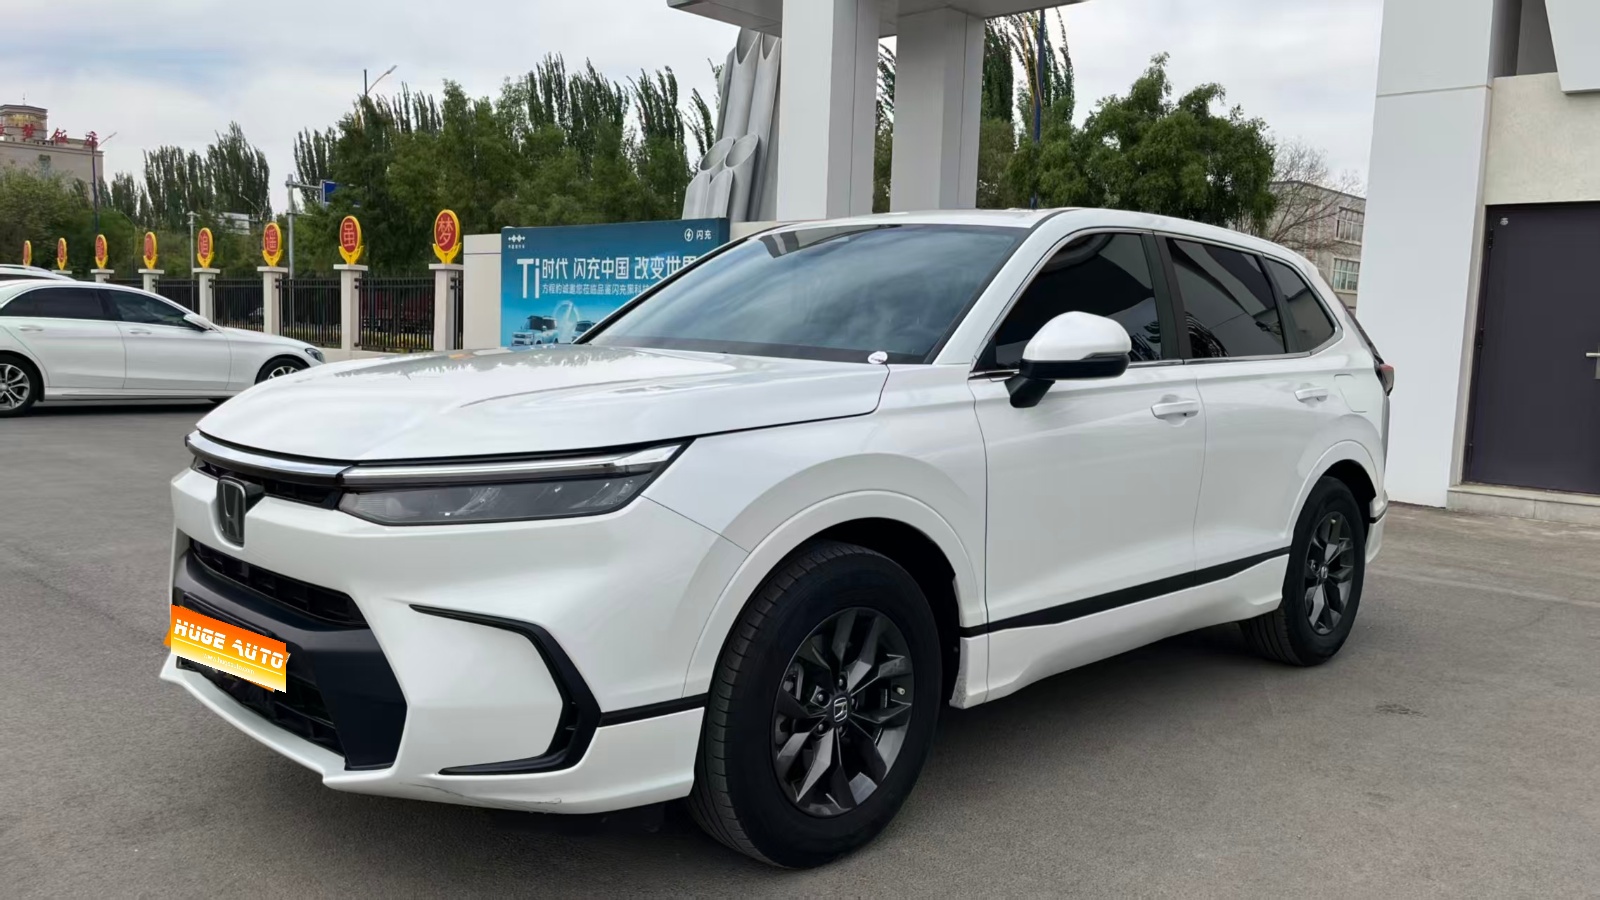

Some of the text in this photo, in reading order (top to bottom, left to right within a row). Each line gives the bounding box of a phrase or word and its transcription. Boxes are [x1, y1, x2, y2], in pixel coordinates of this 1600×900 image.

[343, 222, 355, 247] 虽
[438, 217, 453, 246] 梦
[696, 229, 712, 240] 闪充
[573, 257, 629, 280] 闪充中国
